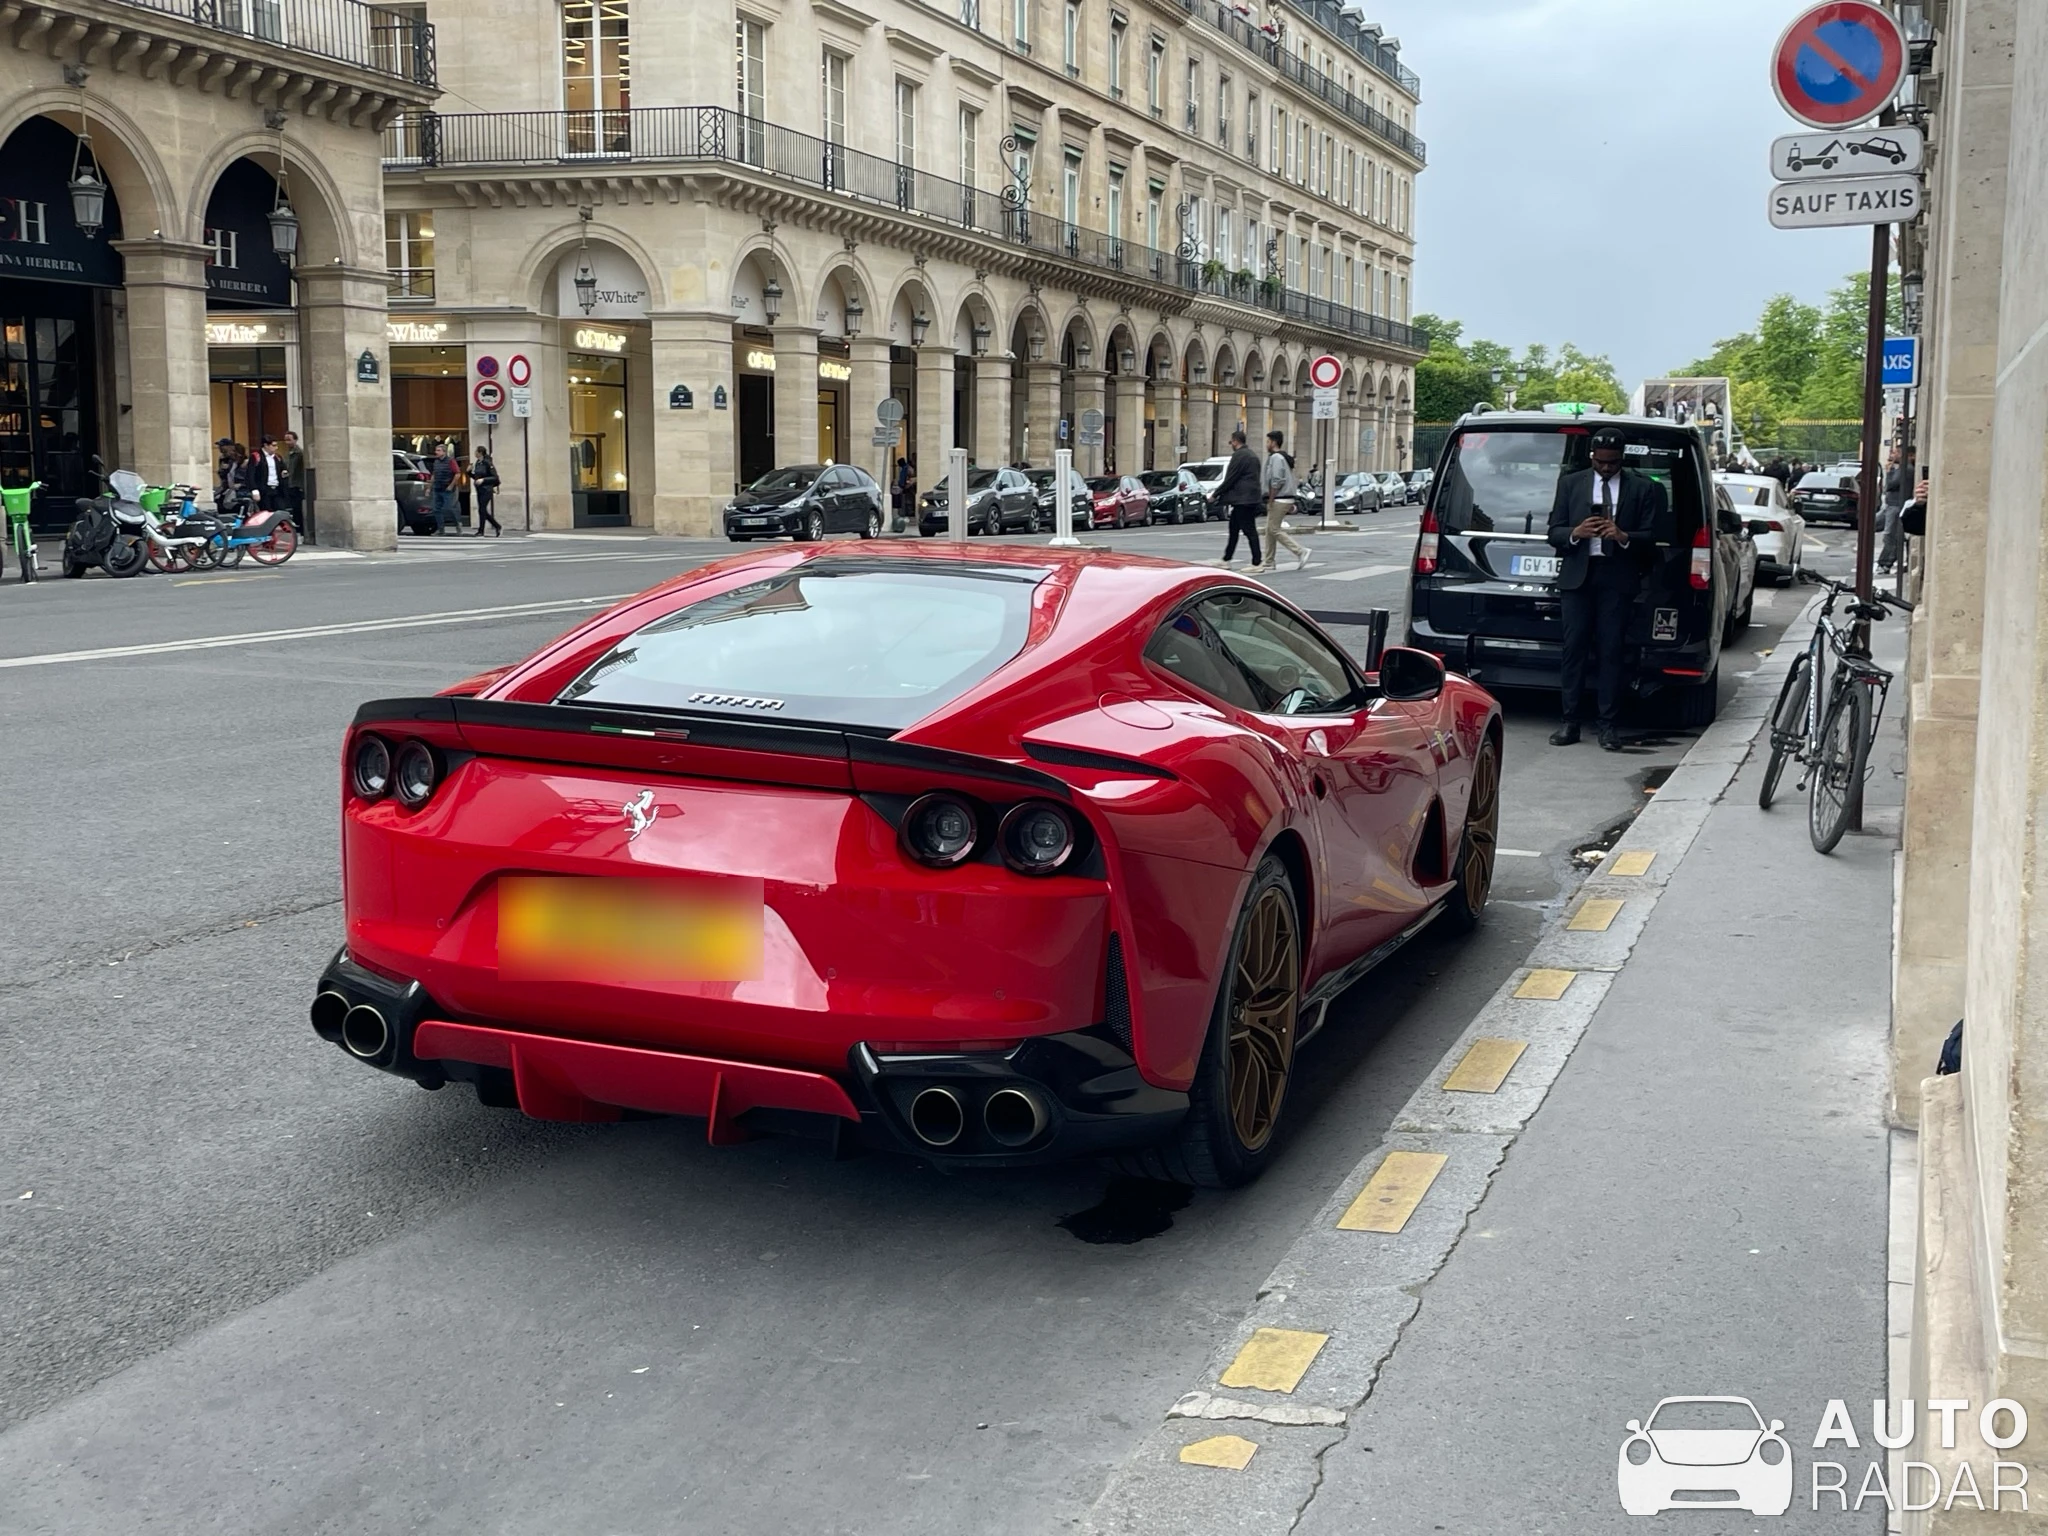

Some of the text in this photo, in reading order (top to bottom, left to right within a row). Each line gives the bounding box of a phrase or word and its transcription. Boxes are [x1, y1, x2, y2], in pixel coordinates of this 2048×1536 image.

[1775, 188, 1914, 215] SAUF TAXIS
[25, 256, 84, 272] HERRERA
[219, 280, 268, 294] HERRERA
